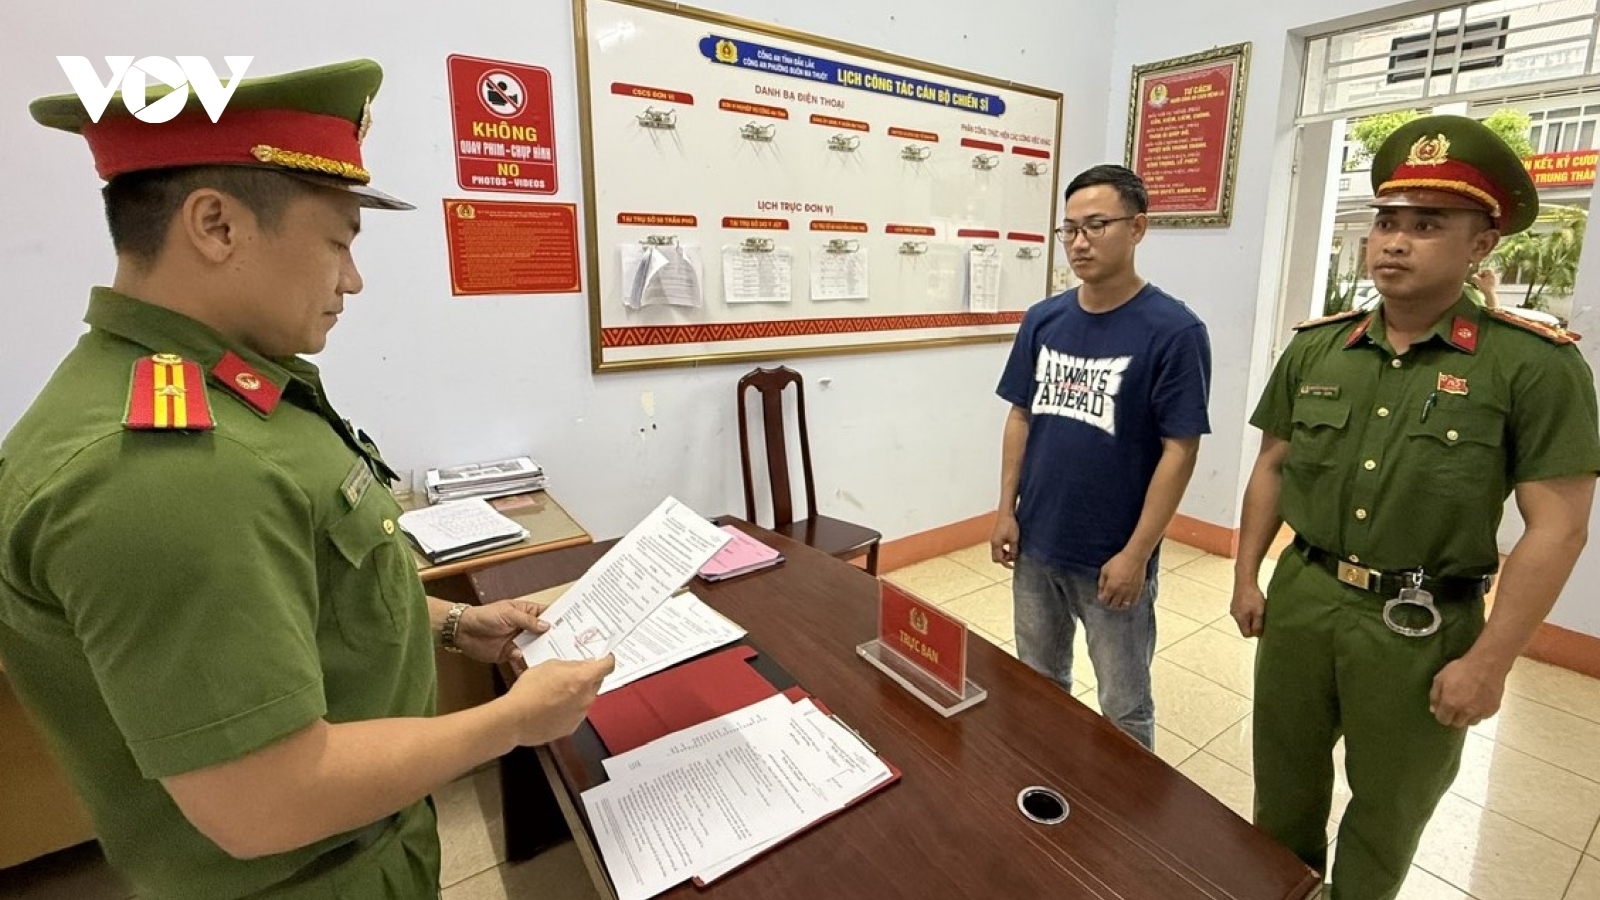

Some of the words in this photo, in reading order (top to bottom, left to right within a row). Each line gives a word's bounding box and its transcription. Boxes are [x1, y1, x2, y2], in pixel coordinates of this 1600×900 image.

[754, 86, 780, 98] DANH
[783, 90, 795, 101] BẠ
[798, 92, 818, 104] ĐIỆN
[820, 96, 845, 108] THOẠI
[838, 69, 861, 86] LỊCH
[864, 73, 893, 91] CÔNG
[895, 80, 915, 96] TÁC
[917, 84, 936, 100] CÁN
[938, 90, 950, 106] BỘ
[952, 92, 978, 108] CHIẾN
[472, 120, 538, 142] KHÔNG
[460, 140, 481, 154] QUAY
[483, 142, 506, 156] PHIM
[511, 144, 531, 161] CHỤP
[532, 144, 551, 160] HÌNH
[498, 162, 520, 176] NO
[1535, 172, 1568, 183] TRUNG
[472, 176, 507, 186] PHOTOS
[514, 178, 545, 188] VIDEOS
[758, 200, 778, 212] LỊCH
[780, 202, 802, 214] TRỰC
[825, 205, 834, 216] VỊ
[1043, 360, 1112, 392] ALWAYS
[1038, 382, 1104, 417] AHEAD
[900, 630, 921, 652] TRỰC
[921, 643, 938, 664] BAN
